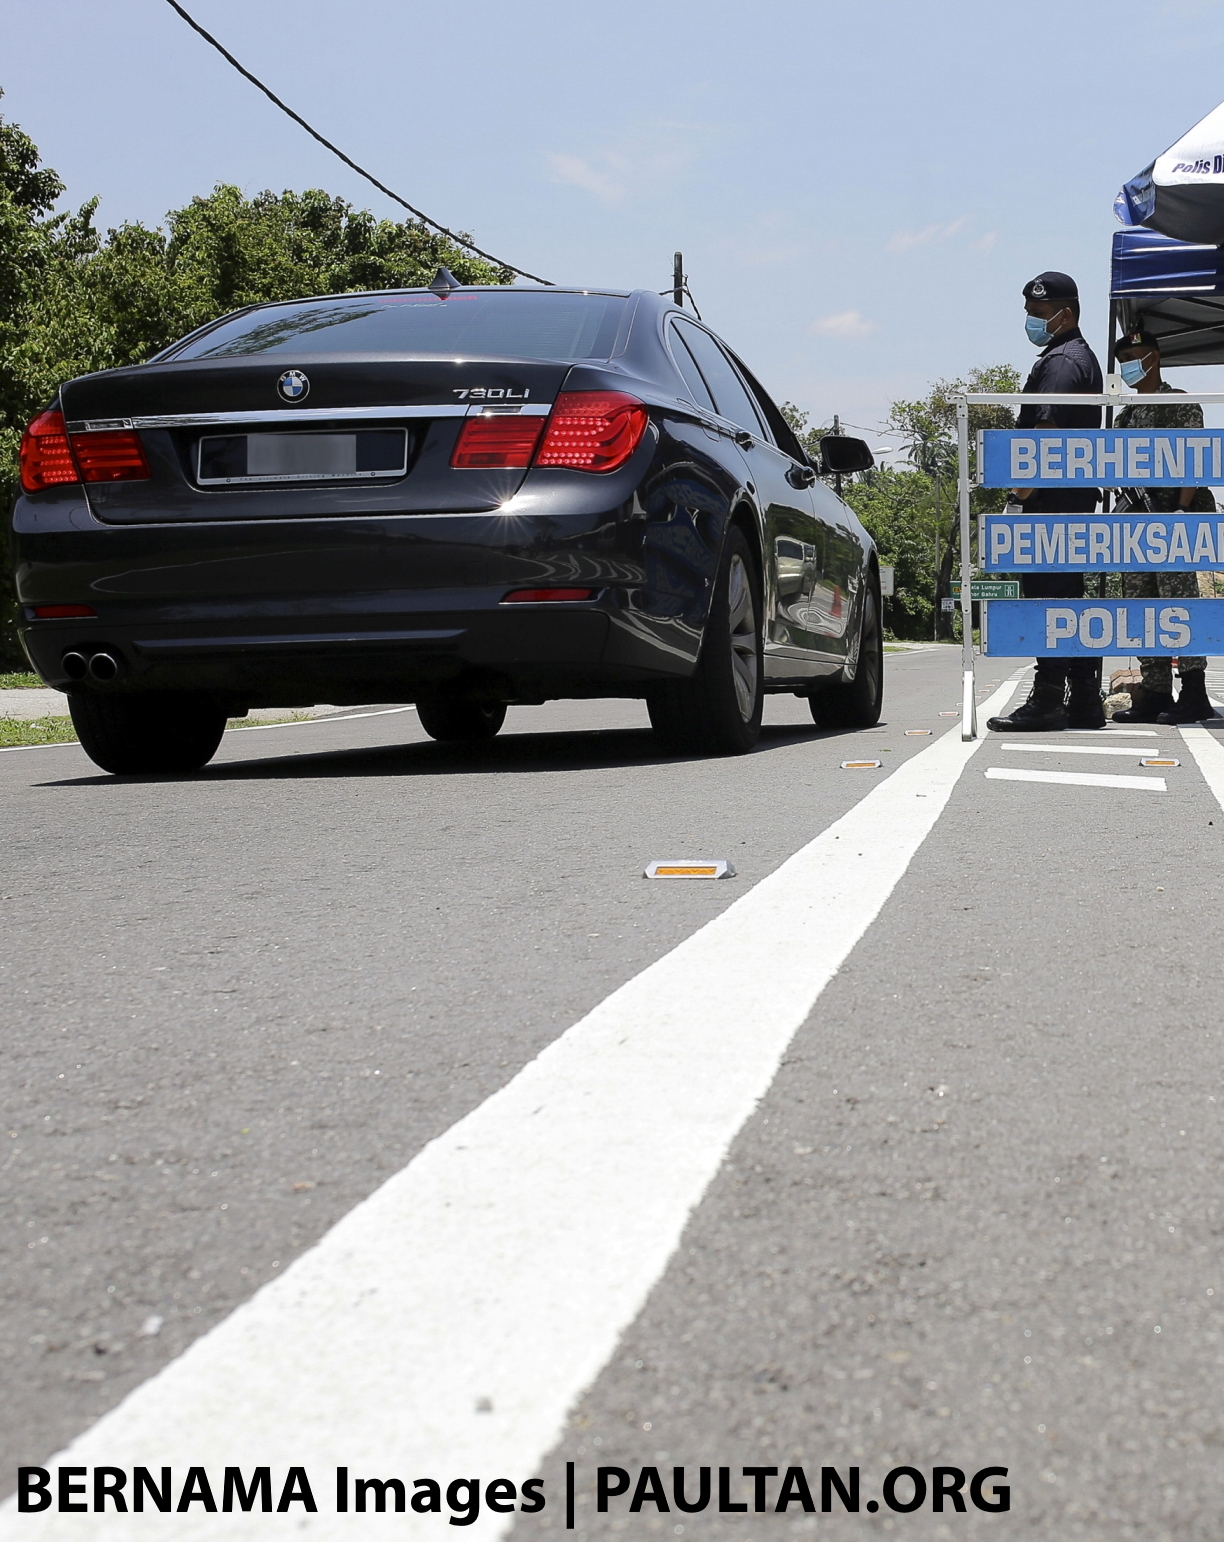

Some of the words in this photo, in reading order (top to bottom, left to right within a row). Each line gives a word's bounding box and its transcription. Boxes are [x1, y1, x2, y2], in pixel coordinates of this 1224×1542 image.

[1171, 159, 1210, 174] Polis
[1010, 437, 1222, 479] BERHENTI
[1046, 606, 1191, 649] POLIS
